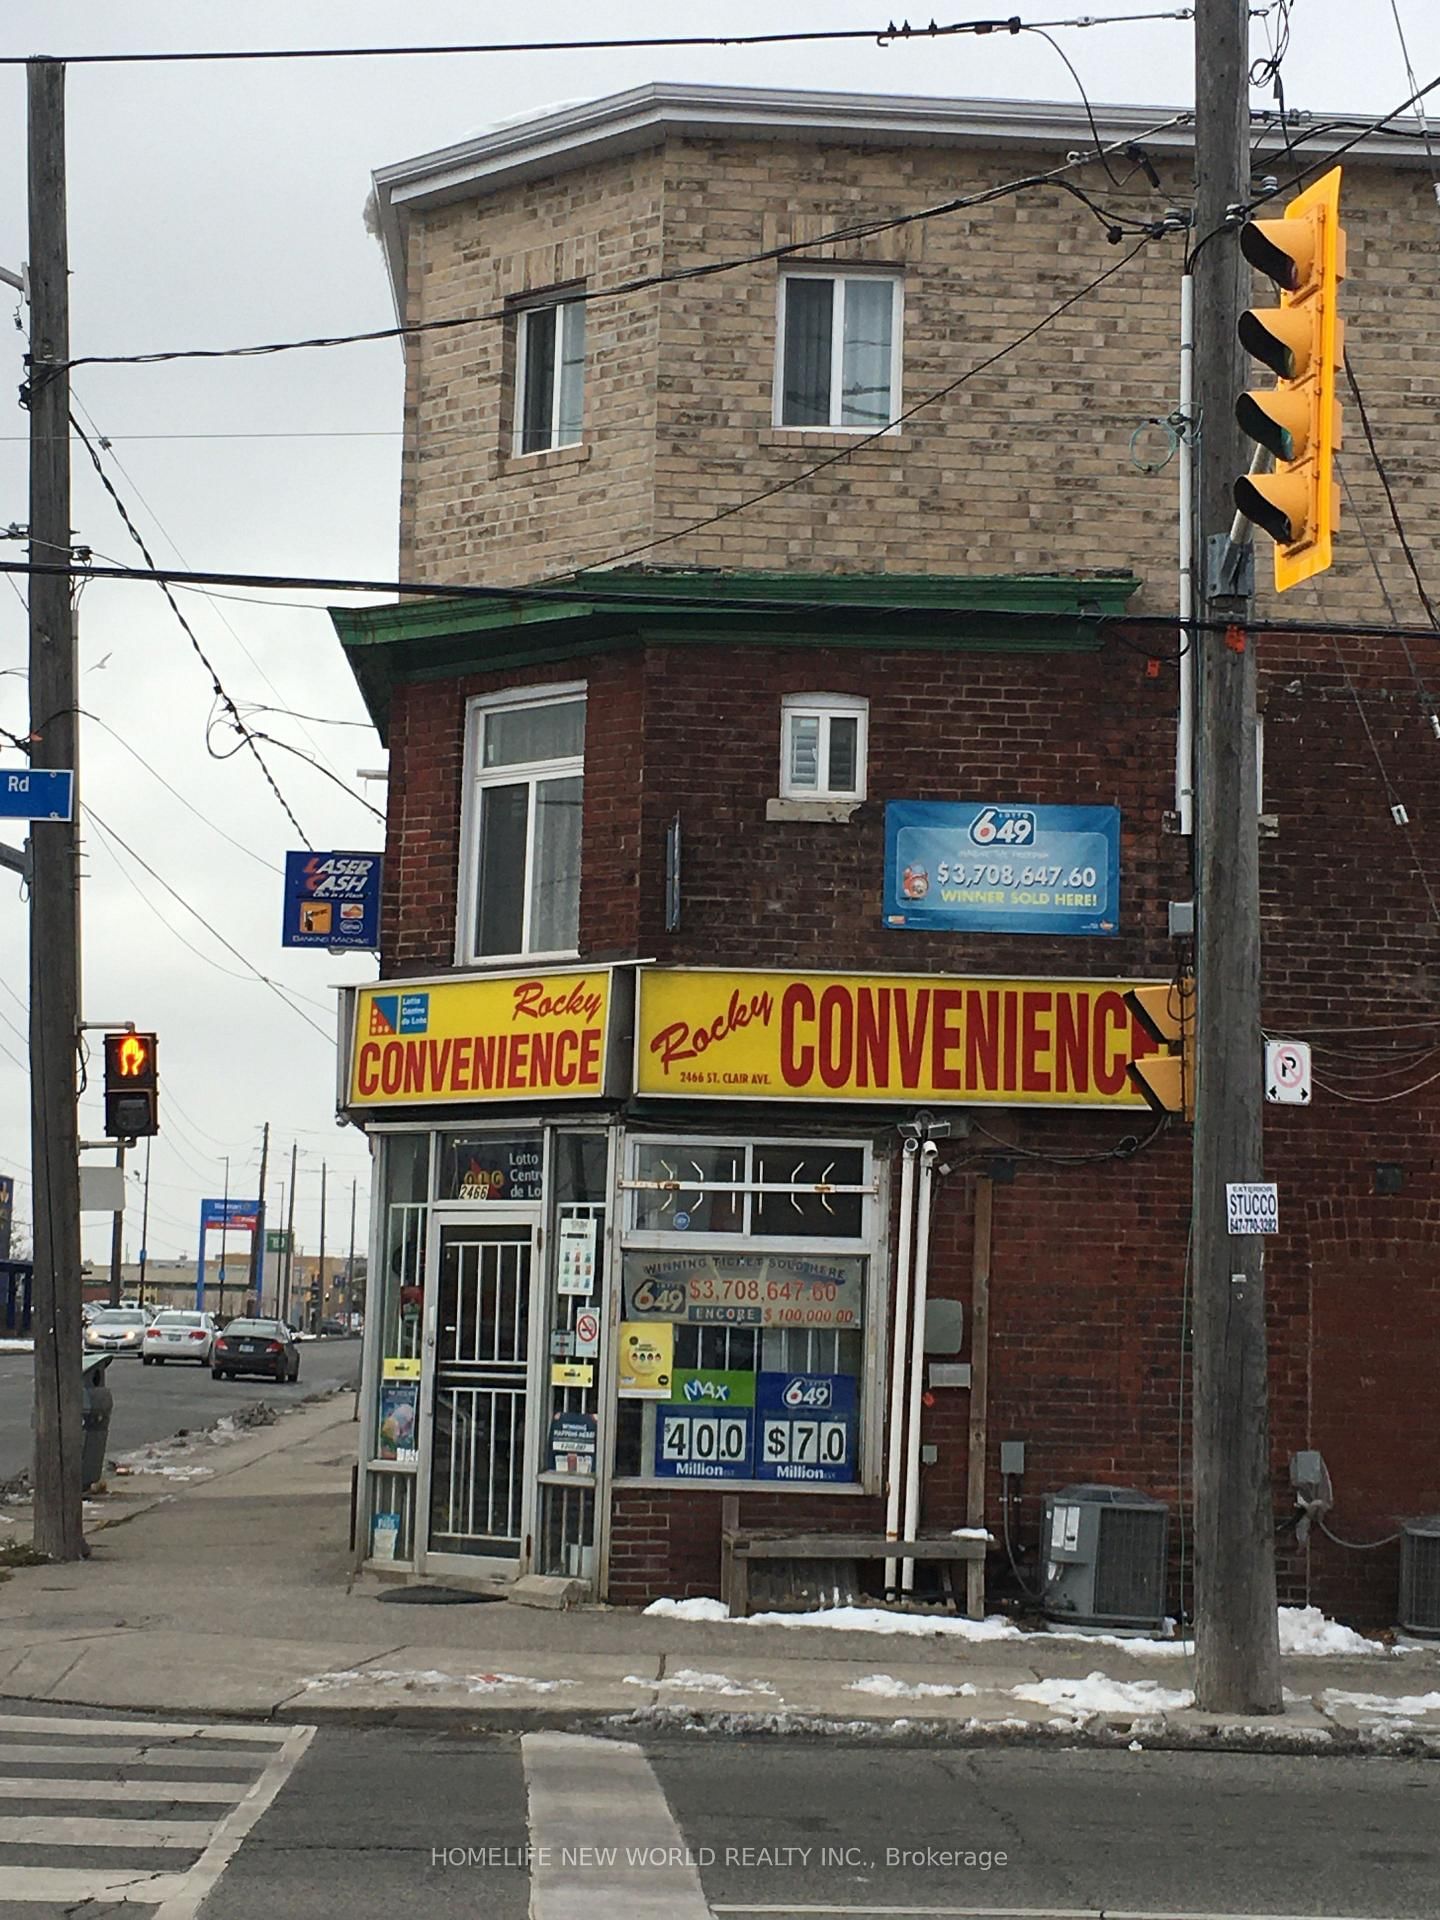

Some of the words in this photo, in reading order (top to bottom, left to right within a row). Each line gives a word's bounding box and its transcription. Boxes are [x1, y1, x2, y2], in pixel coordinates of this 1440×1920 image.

[8, 775, 30, 792] Rd
[973, 811, 1032, 843] 649
[303, 857, 373, 875] LASER
[936, 861, 1097, 889] $3,708,647.60
[305, 873, 368, 893] CASH
[941, 889, 1004, 904] WINNER
[1010, 891, 1050, 905] SOLD
[1055, 893, 1097, 907] HERE!
[511, 980, 603, 1024] Rocky
[650, 988, 774, 1076] Rocky
[358, 1028, 602, 1096] CONVENIENCE
[680, 1071, 704, 1083] 2466
[707, 1072, 720, 1083] ST.
[722, 1073, 749, 1084] CLAIR
[751, 1074, 772, 1085] AVE.
[508, 1152, 539, 1165] Lotto
[459, 1185, 489, 1199] 2466
[511, 1184, 524, 1198] de
[1230, 1193, 1276, 1215] STUCCO
[643, 1258, 707, 1275] WINNING
[712, 1257, 763, 1267] TICKET
[768, 1258, 804, 1271] SOLD
[809, 1263, 846, 1280] HERE
[634, 1281, 683, 1312] 649
[696, 1308, 755, 1321] ENCORE
[683, 1379, 729, 1402] MAX
[786, 1378, 829, 1405] 649
[767, 1426, 845, 1463] $7.0
[676, 1462, 724, 1477] Million
[776, 1465, 825, 1480] Million
